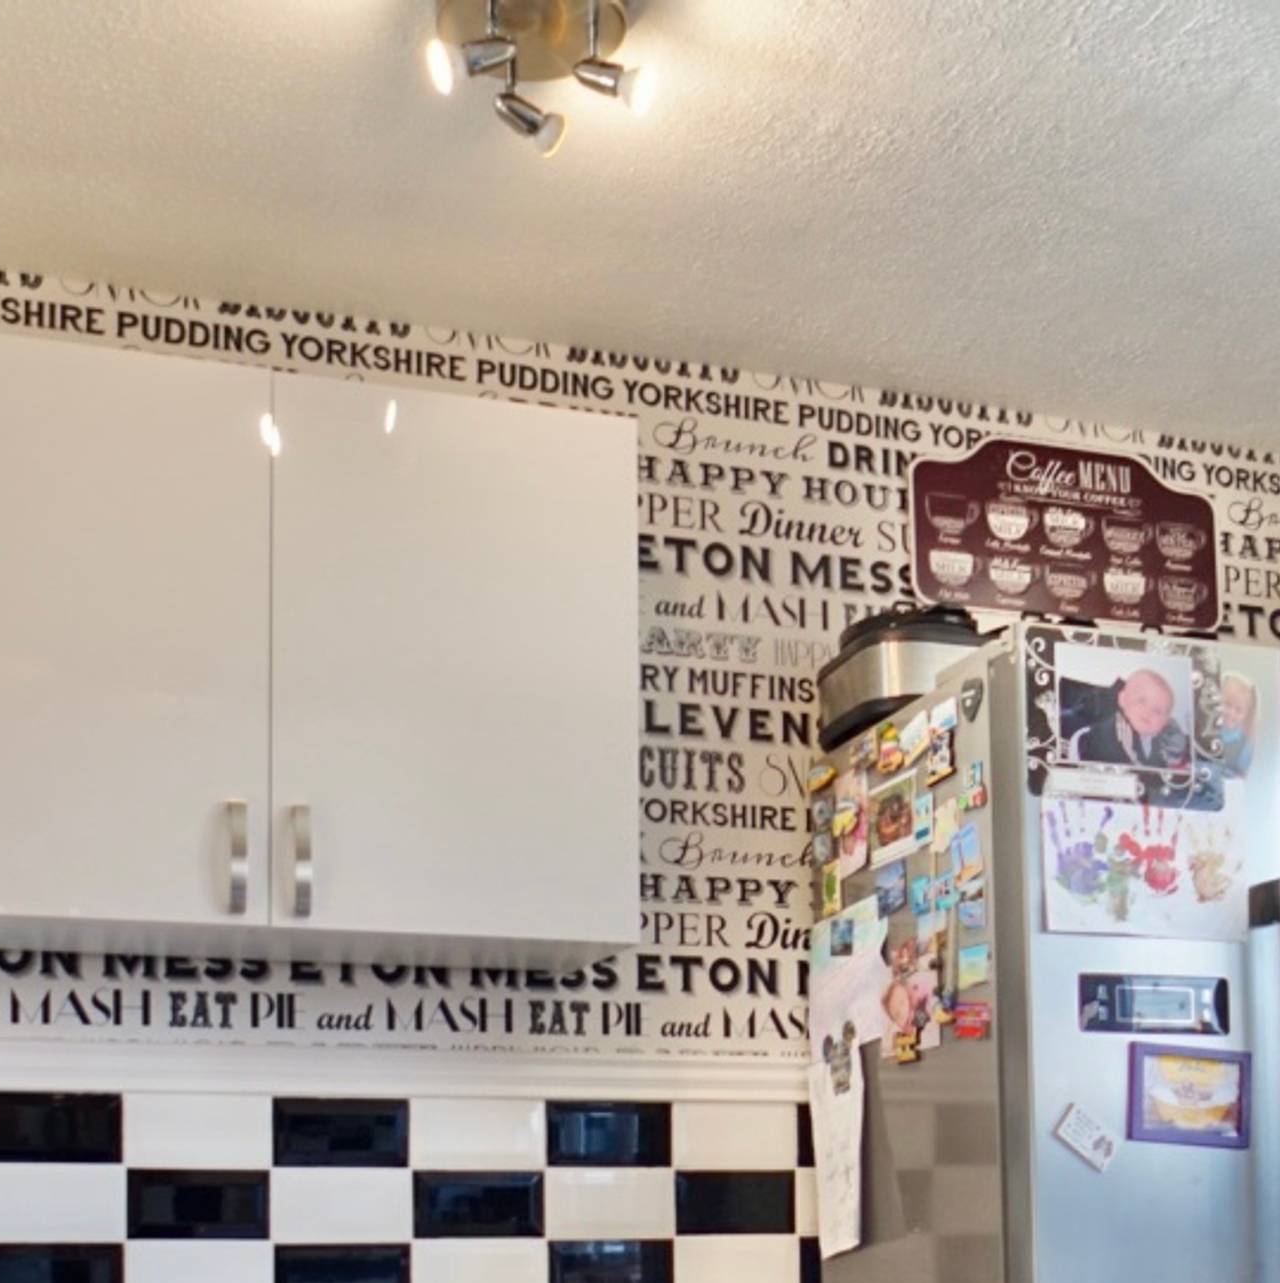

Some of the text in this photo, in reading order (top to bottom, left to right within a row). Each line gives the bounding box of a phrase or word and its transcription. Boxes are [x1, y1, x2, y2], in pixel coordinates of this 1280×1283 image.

[117, 311, 268, 356] PUDDING
[280, 332, 466, 381] YORKSHIRE
[476, 360, 614, 400] PUDDING
[623, 379, 790, 426] YORKSHIRE
[798, 403, 922, 443] PUDDING
[653, 416, 817, 462] Brunch
[827, 441, 918, 478] DRIN
[638, 454, 790, 500] HAPPY
[1006, 449, 1131, 495] Coffee MENU
[738, 500, 865, 549] Dinner
[654, 594, 706, 620] and
[716, 590, 830, 631] MASH
[687, 669, 816, 704] MUFFINS
[639, 744, 746, 795] CUITS
[640, 797, 796, 832] ORKSHIRE
[640, 872, 800, 908] HAPPY
[636, 953, 781, 997] ETON
[10, 987, 152, 1027] MASH
[168, 990, 238, 1029] EAT
[250, 992, 306, 1031] PIE
[316, 1002, 375, 1032] and
[385, 996, 513, 1034] MASH
[528, 1000, 591, 1036] EAT
[601, 1001, 650, 1037] PIE
[660, 1012, 712, 1038] and
